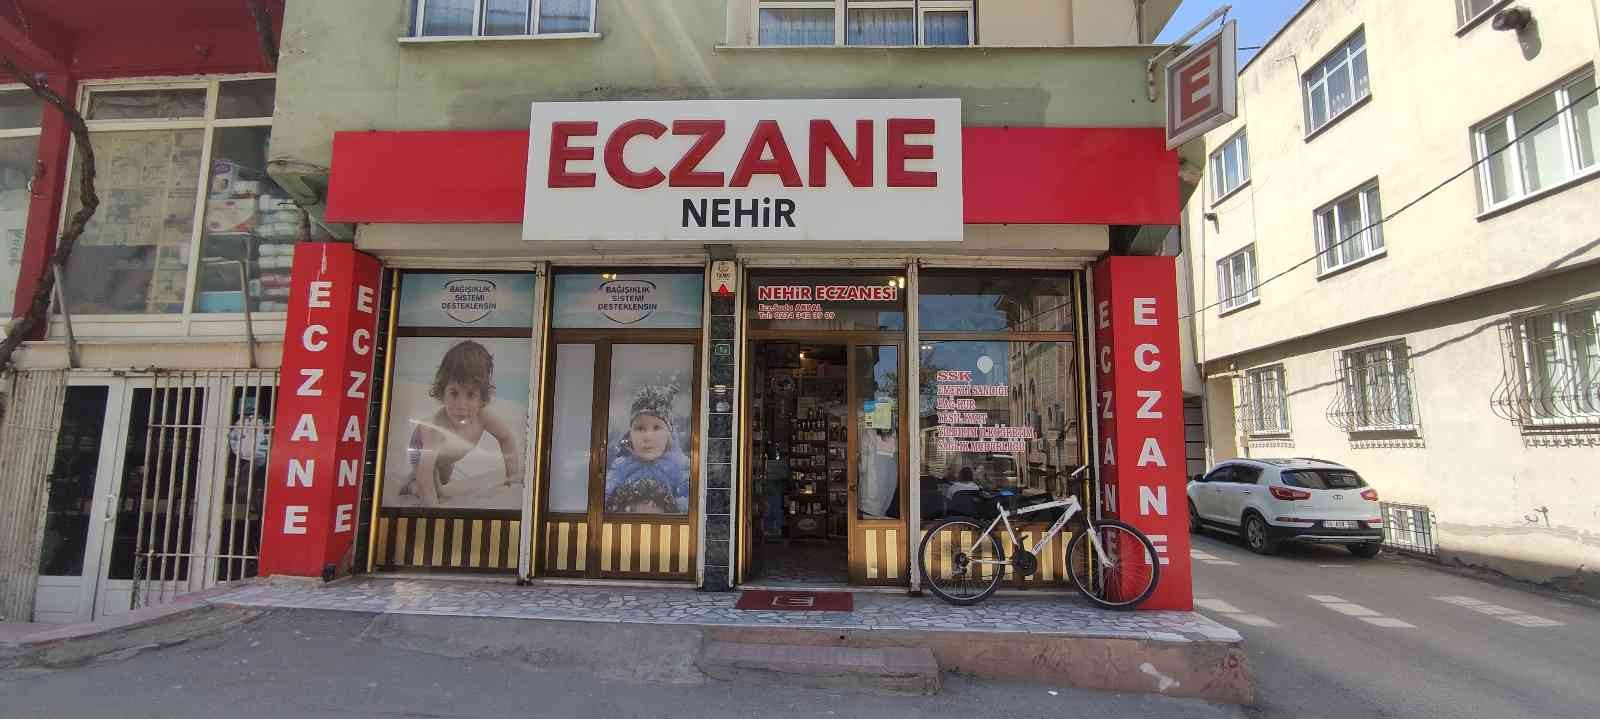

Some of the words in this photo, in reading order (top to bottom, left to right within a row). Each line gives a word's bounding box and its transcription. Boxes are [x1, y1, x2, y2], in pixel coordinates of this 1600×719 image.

[548, 118, 938, 190] ECZANE
[1180, 52, 1211, 120] E
[283, 280, 333, 535] ECZANE
[334, 284, 375, 533] ECZANE
[936, 370, 973, 382] SSK
[1133, 297, 1170, 565] ECZANE
